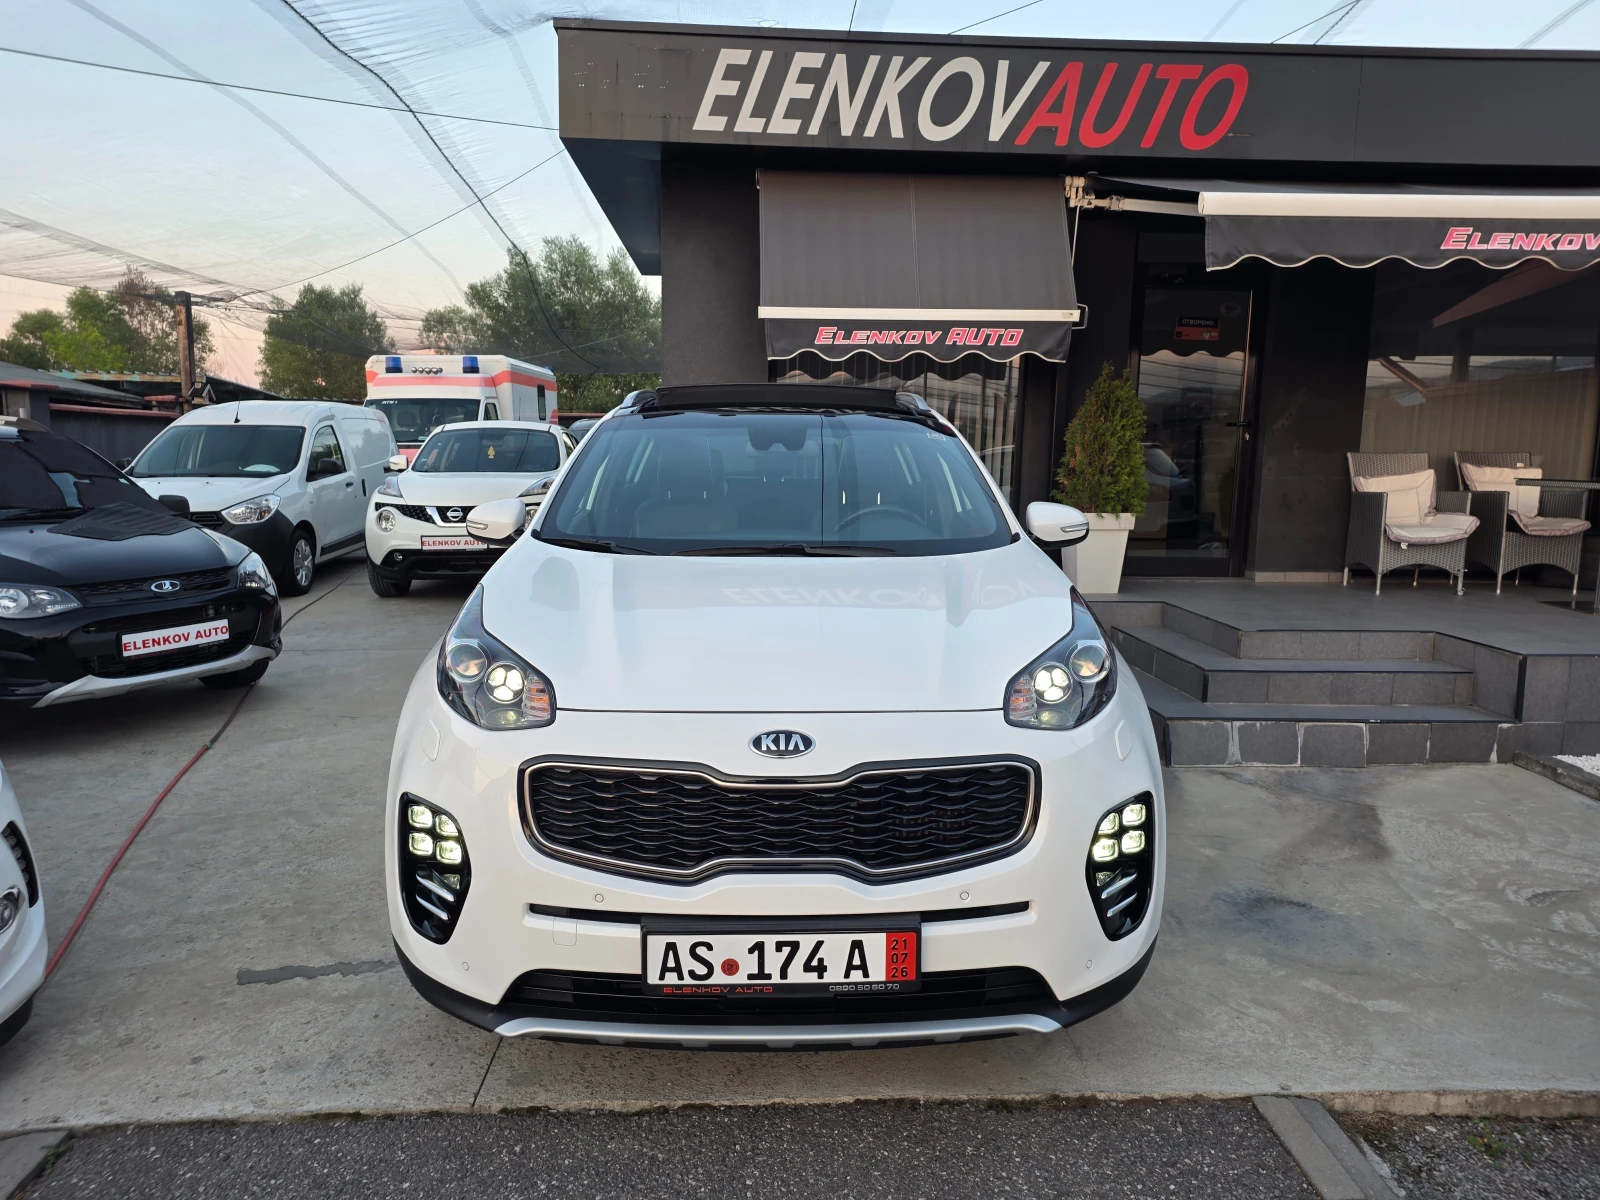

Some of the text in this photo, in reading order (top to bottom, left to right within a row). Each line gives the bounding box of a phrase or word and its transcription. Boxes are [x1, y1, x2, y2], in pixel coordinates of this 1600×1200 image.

[1182, 318, 1214, 326] ОТВОРЕНО
[946, 327, 1024, 346] AUTO
[123, 625, 229, 652] ELENKOV AUTO
[760, 733, 806, 751] KIA
[891, 938, 908, 950] 21
[658, 939, 870, 981] AS 174 A
[891, 952, 909, 964] 07
[890, 966, 909, 978] 26
